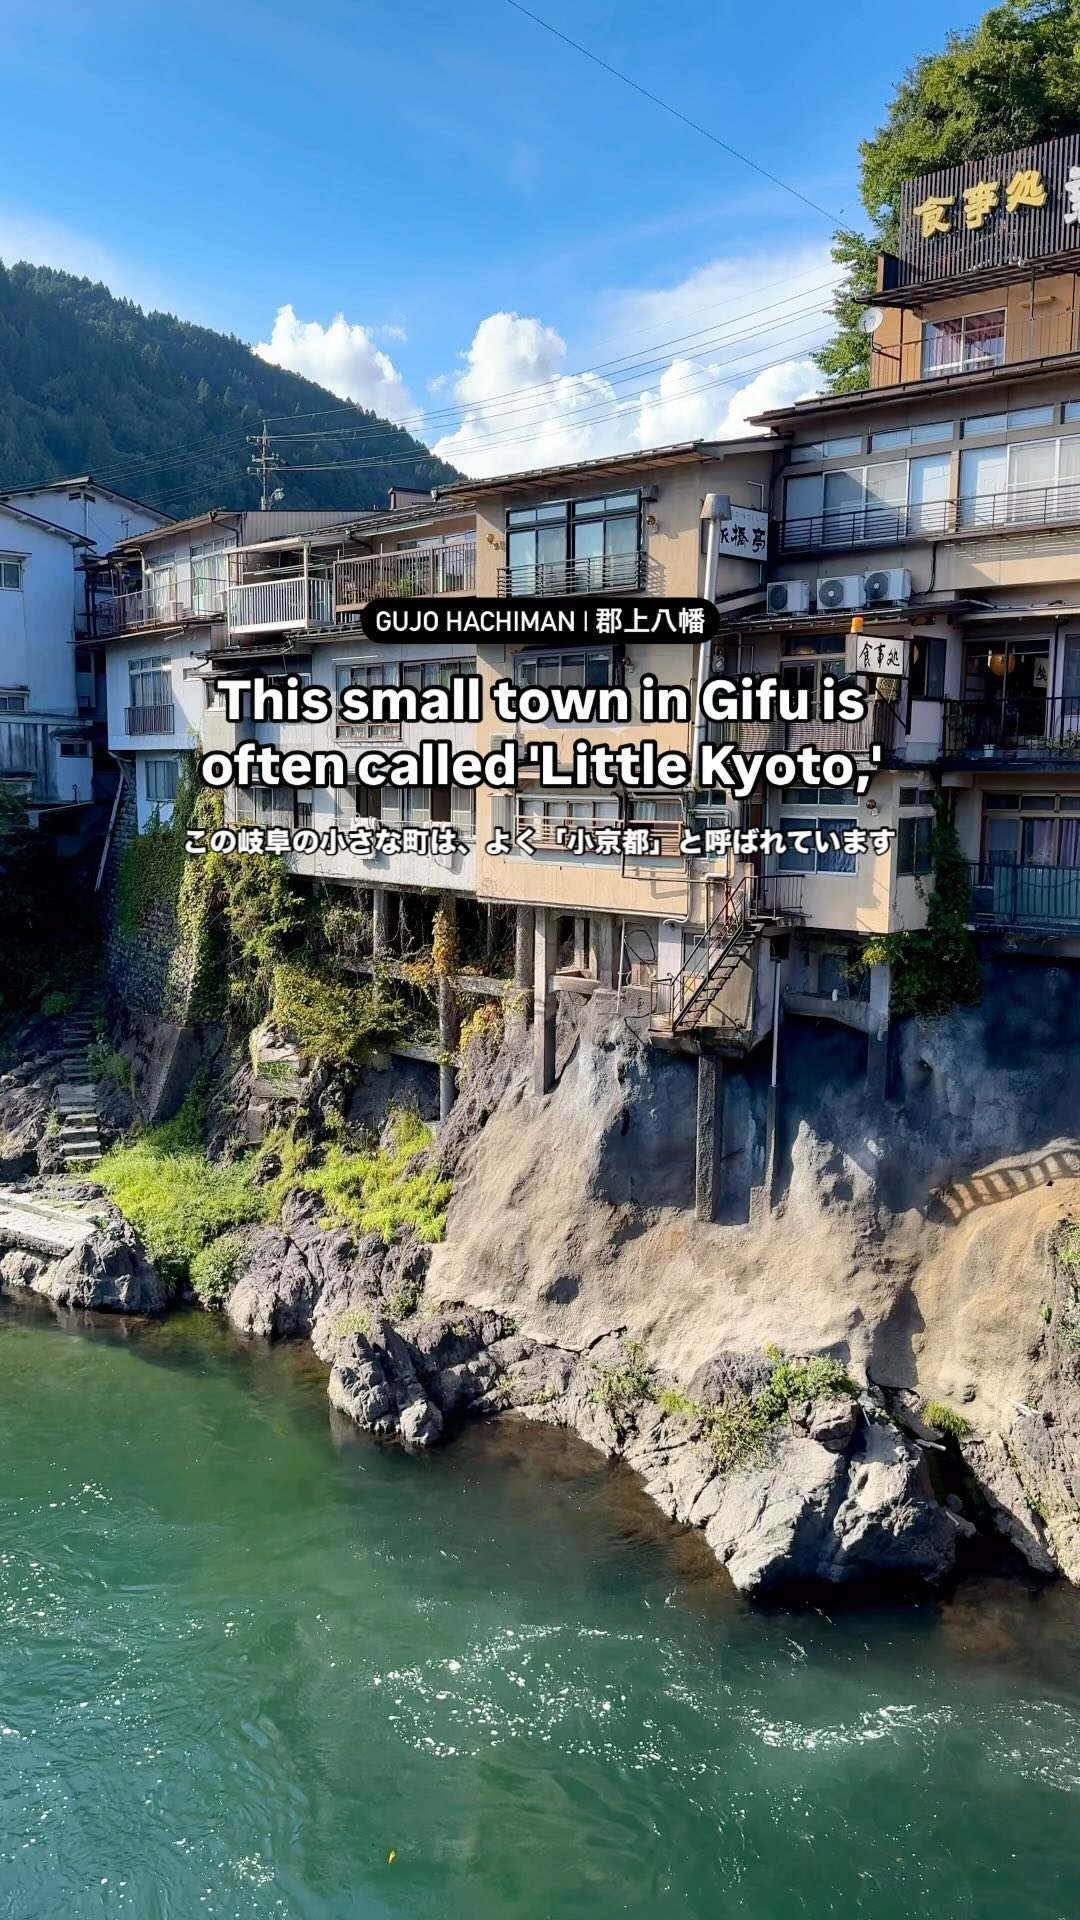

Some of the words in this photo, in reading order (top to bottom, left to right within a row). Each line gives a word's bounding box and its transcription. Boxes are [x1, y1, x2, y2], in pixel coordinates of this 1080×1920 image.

[913, 169, 1047, 238] 食事処
[859, 641, 900, 668] 食事処
